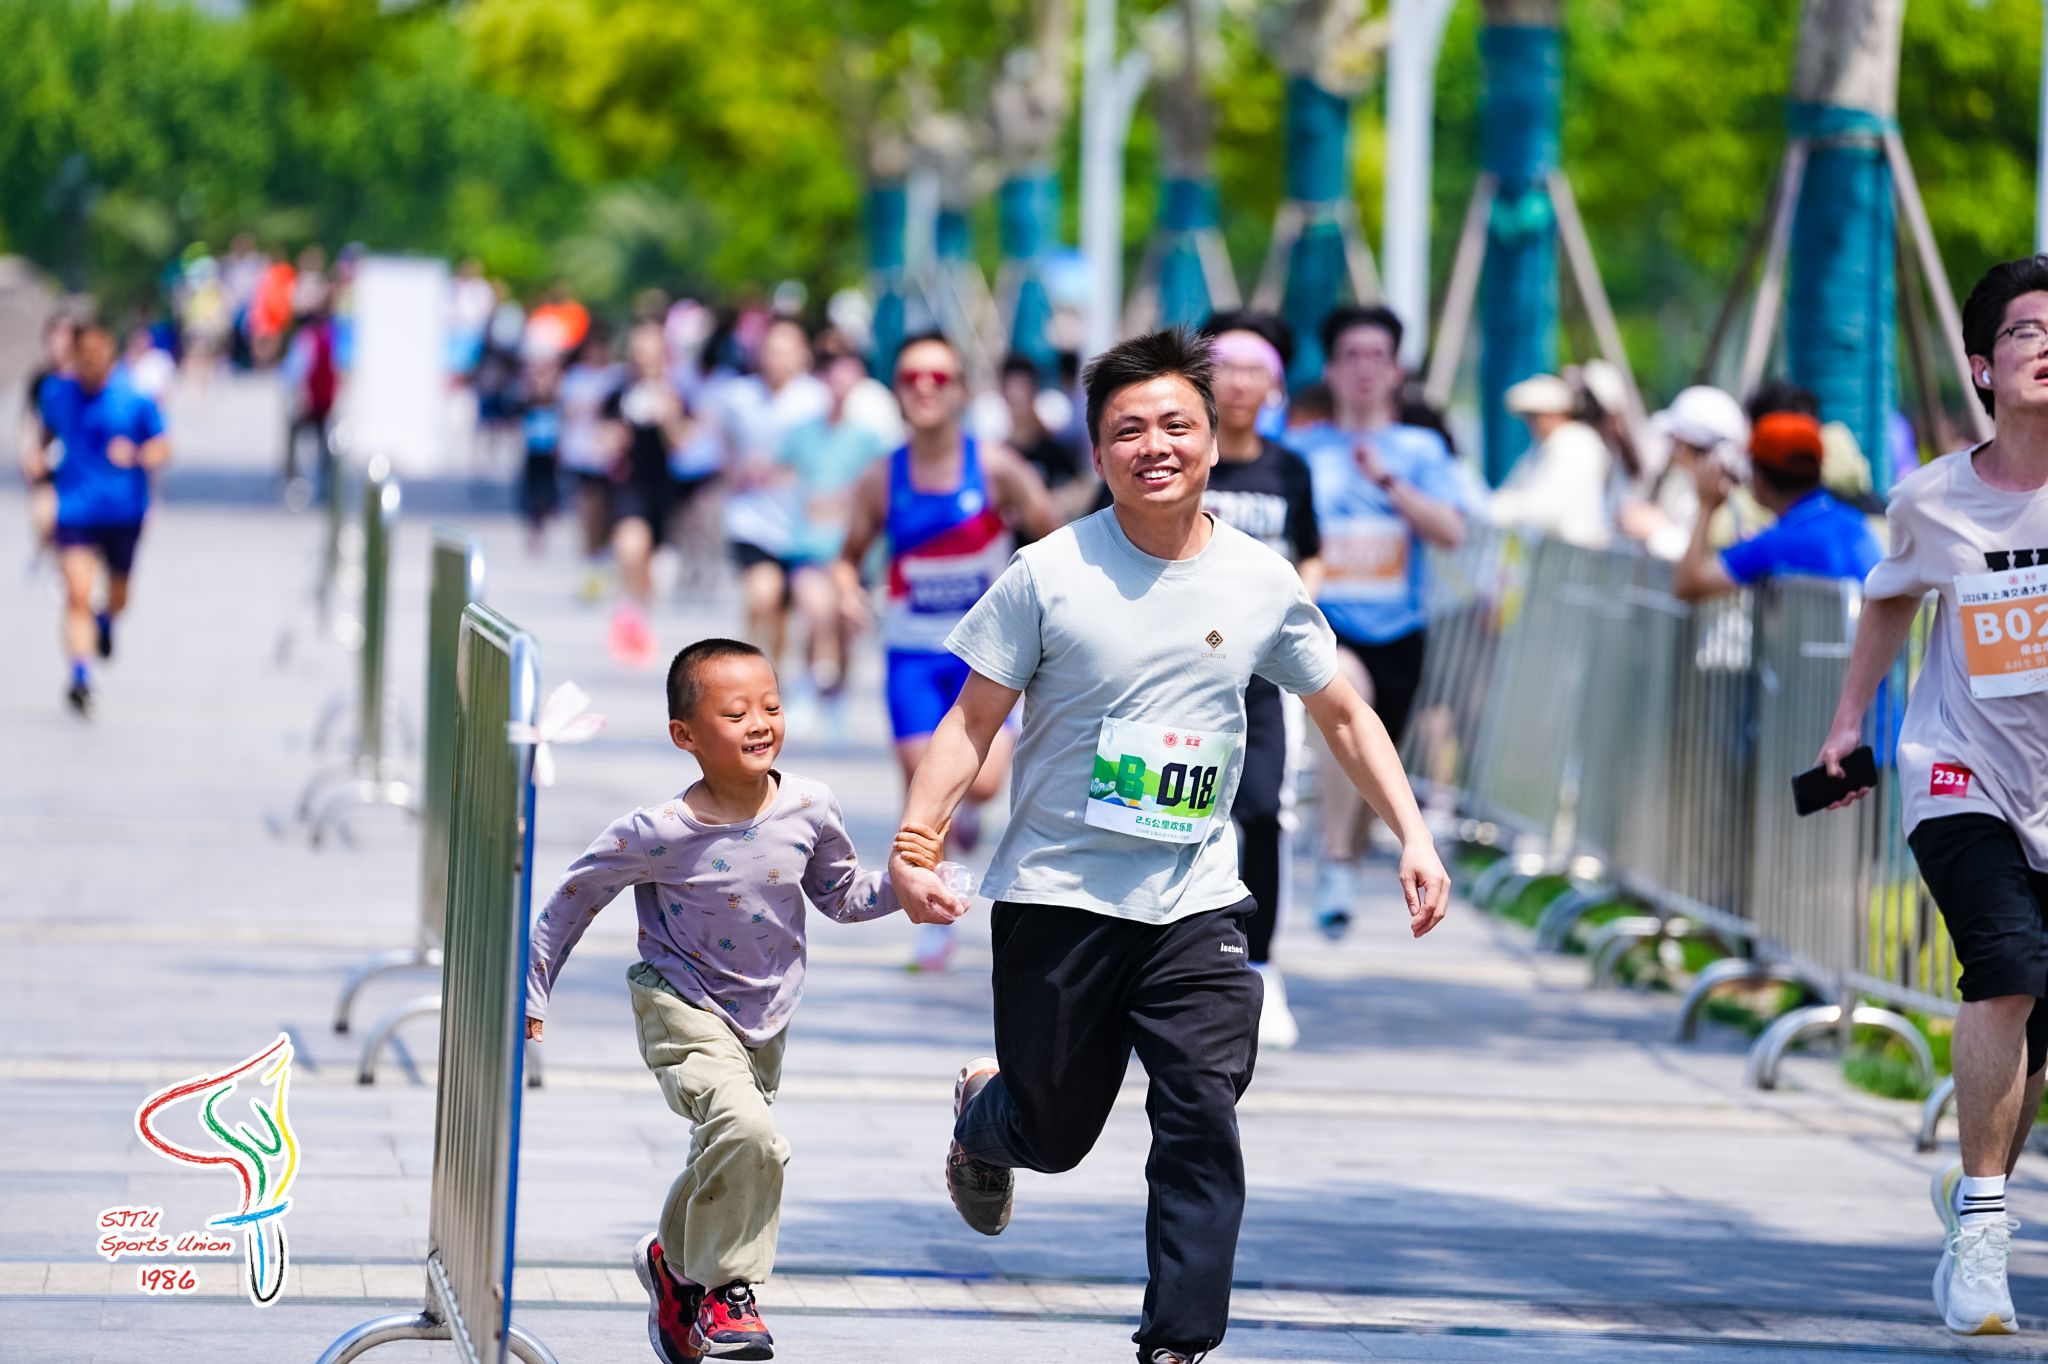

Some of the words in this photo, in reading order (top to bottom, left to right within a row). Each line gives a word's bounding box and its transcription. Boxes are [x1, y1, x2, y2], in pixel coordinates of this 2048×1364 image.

[1116, 754, 1146, 801] B
[1156, 762, 1218, 810] 018
[1933, 769, 1966, 786] 231
